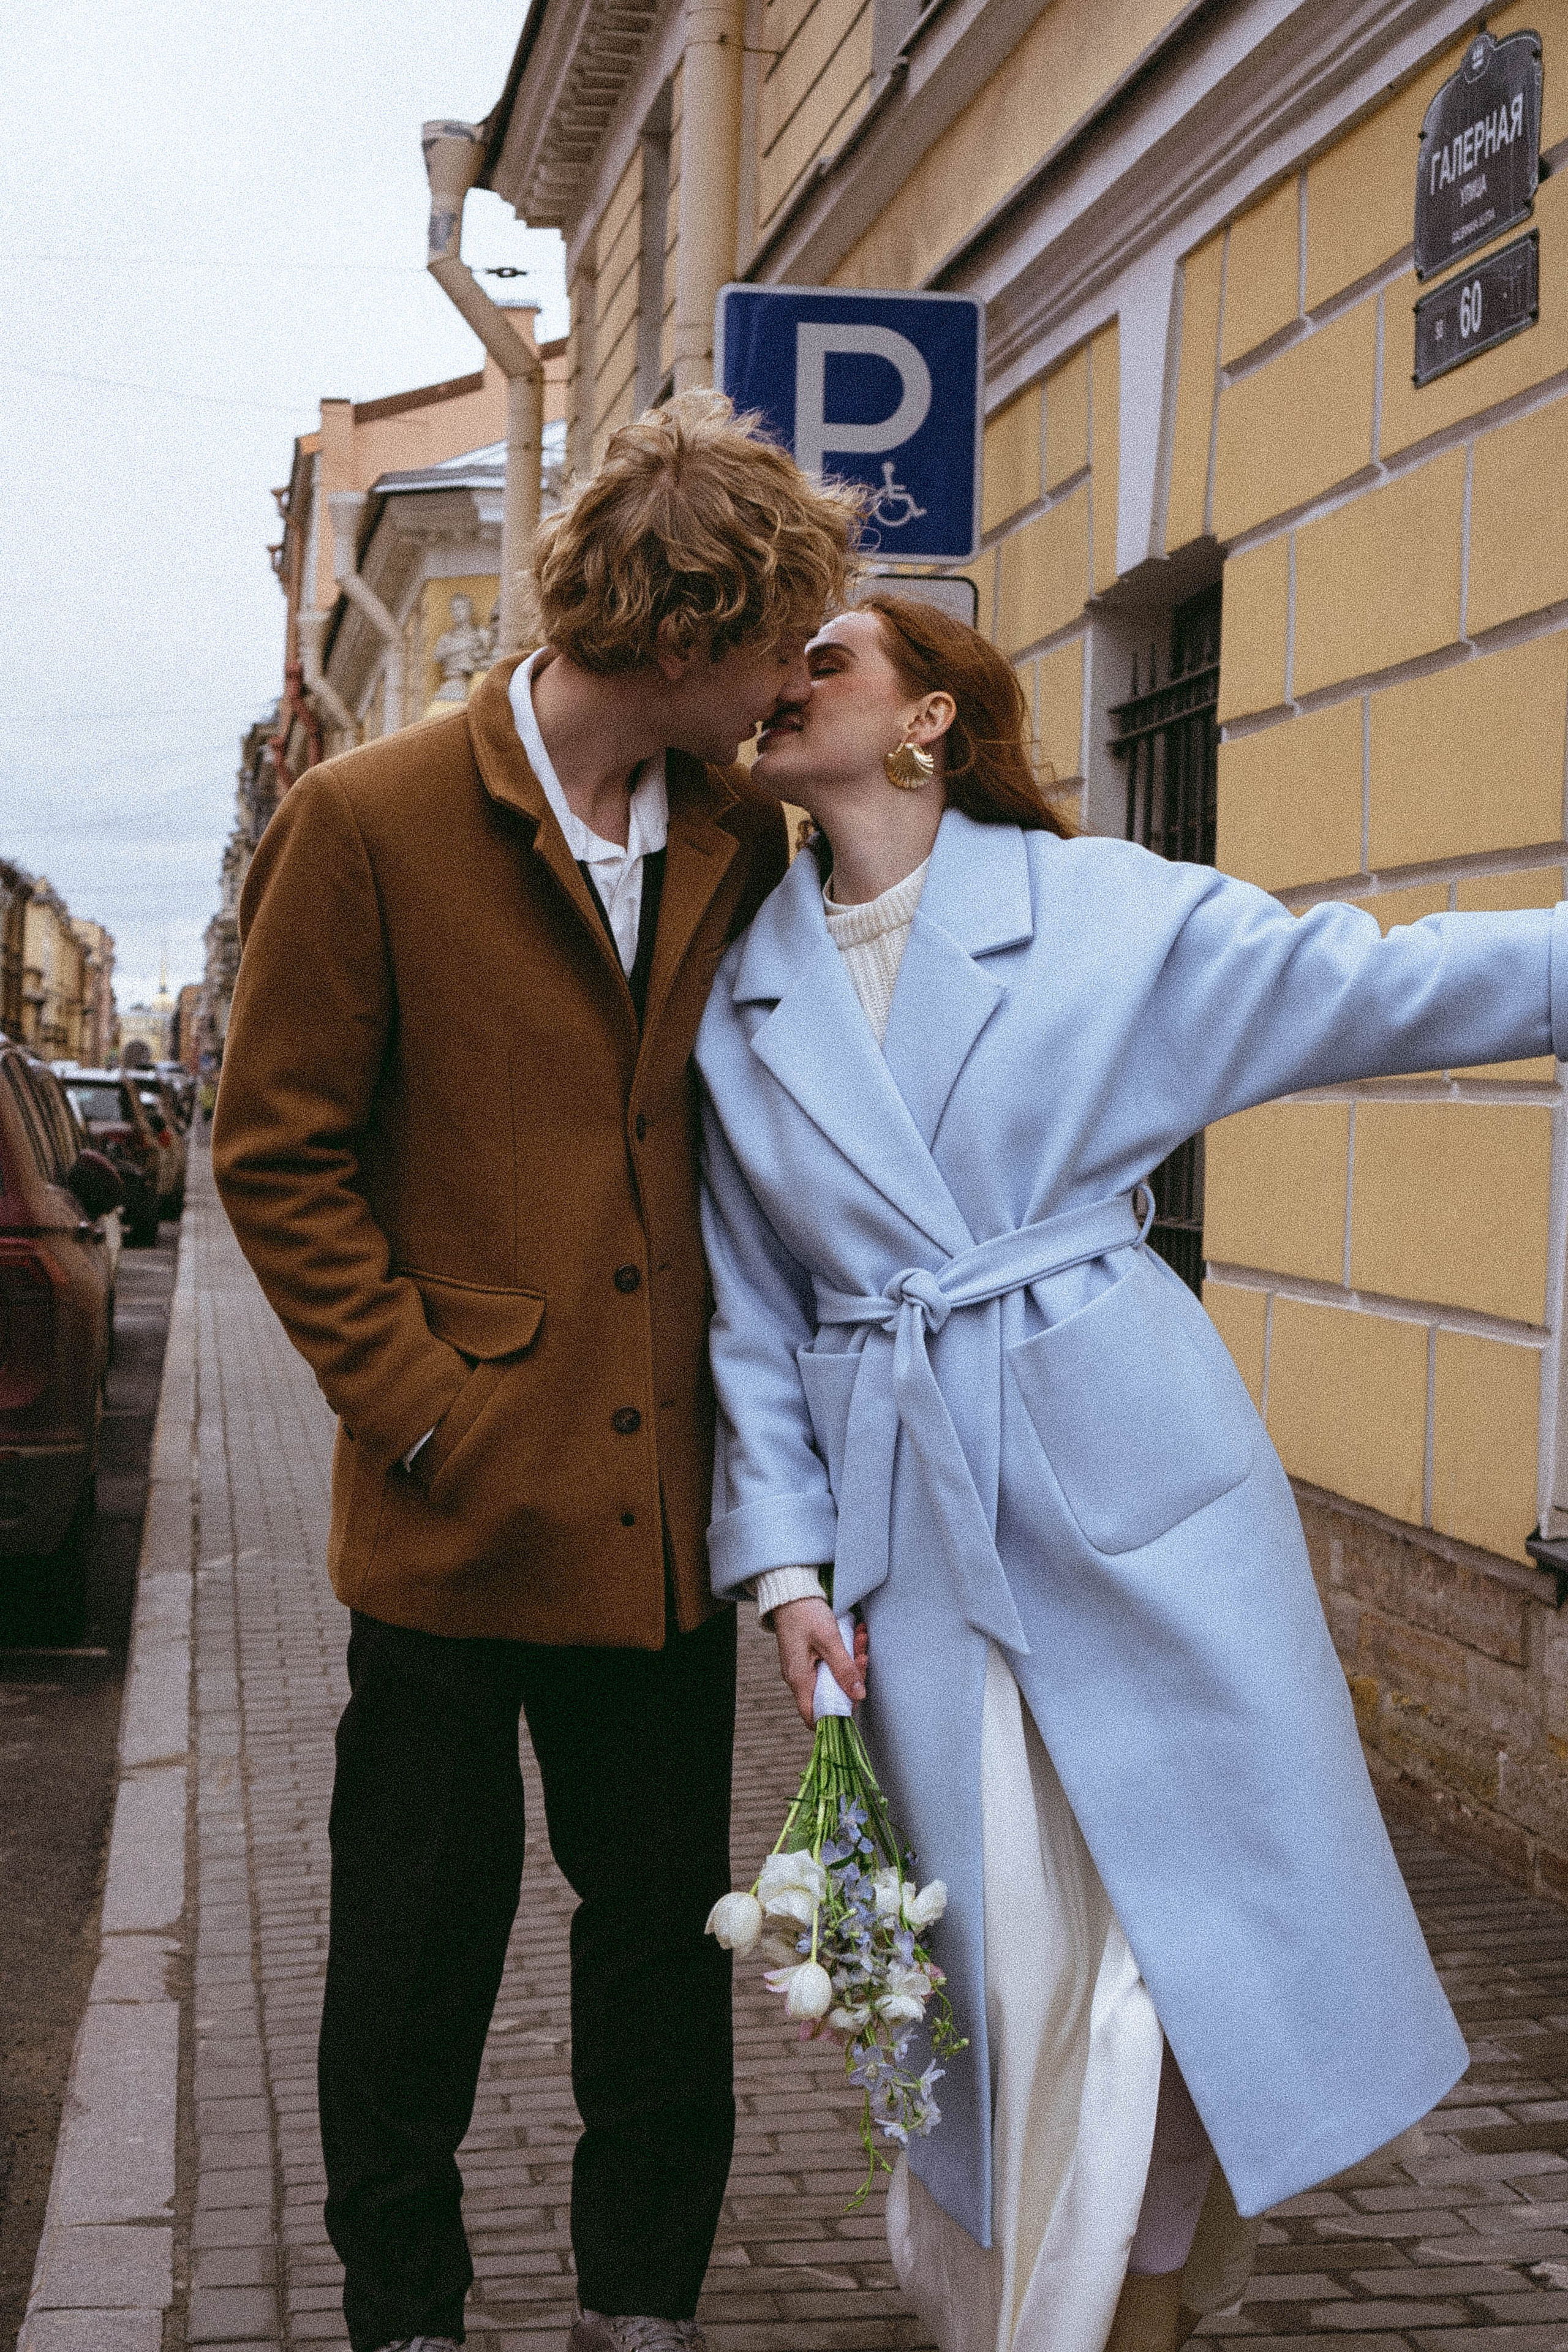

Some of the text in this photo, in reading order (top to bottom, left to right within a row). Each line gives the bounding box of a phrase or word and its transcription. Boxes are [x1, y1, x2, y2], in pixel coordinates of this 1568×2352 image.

[1430, 92, 1524, 195] ГАЛЕРНАЯ
[1460, 280, 1483, 339] 60
[796, 322, 932, 492] P
